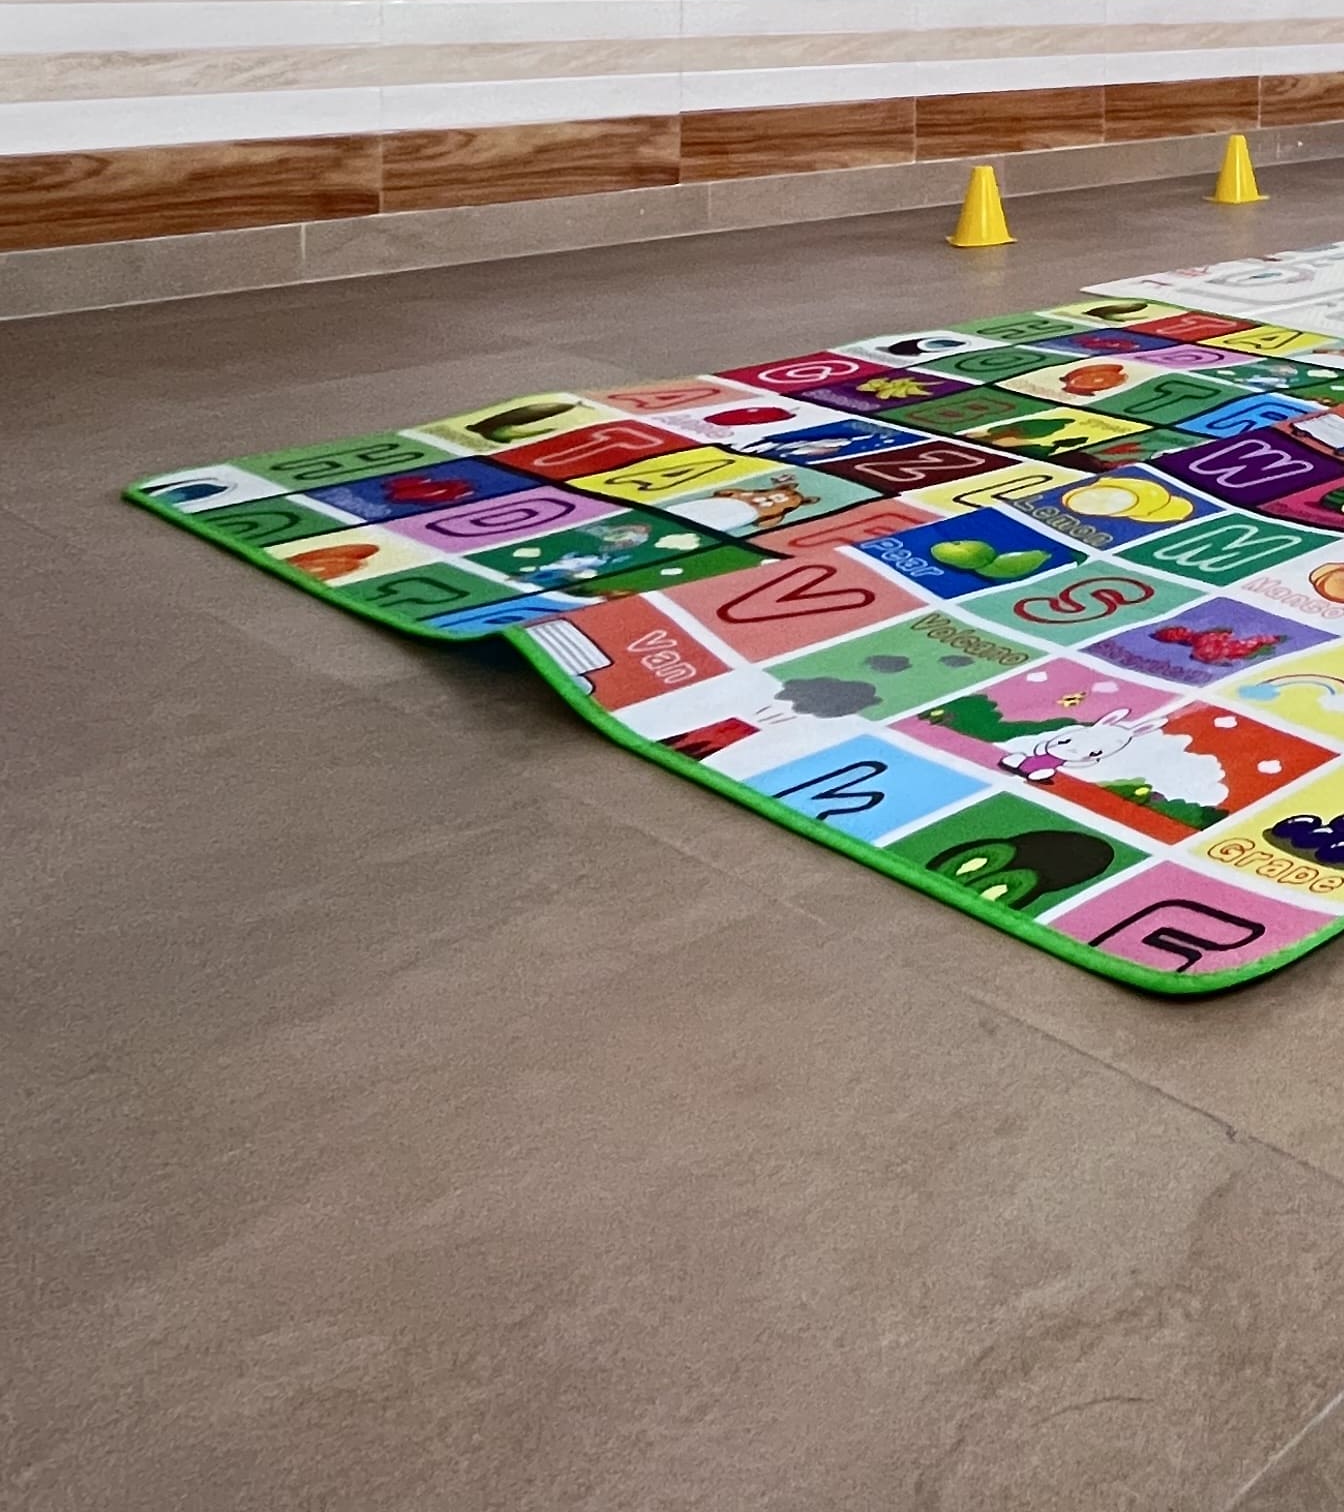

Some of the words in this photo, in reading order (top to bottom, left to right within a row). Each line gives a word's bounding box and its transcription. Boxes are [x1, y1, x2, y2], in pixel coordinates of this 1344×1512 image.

[604, 459, 736, 491] A
[1012, 494, 1115, 547] Lemon
[861, 538, 945, 578] Pear
[1153, 524, 1303, 573] M
[716, 564, 876, 624] V
[1013, 576, 1155, 625] S
[626, 629, 697, 684] Van
[910, 611, 1029, 667] Volcano
